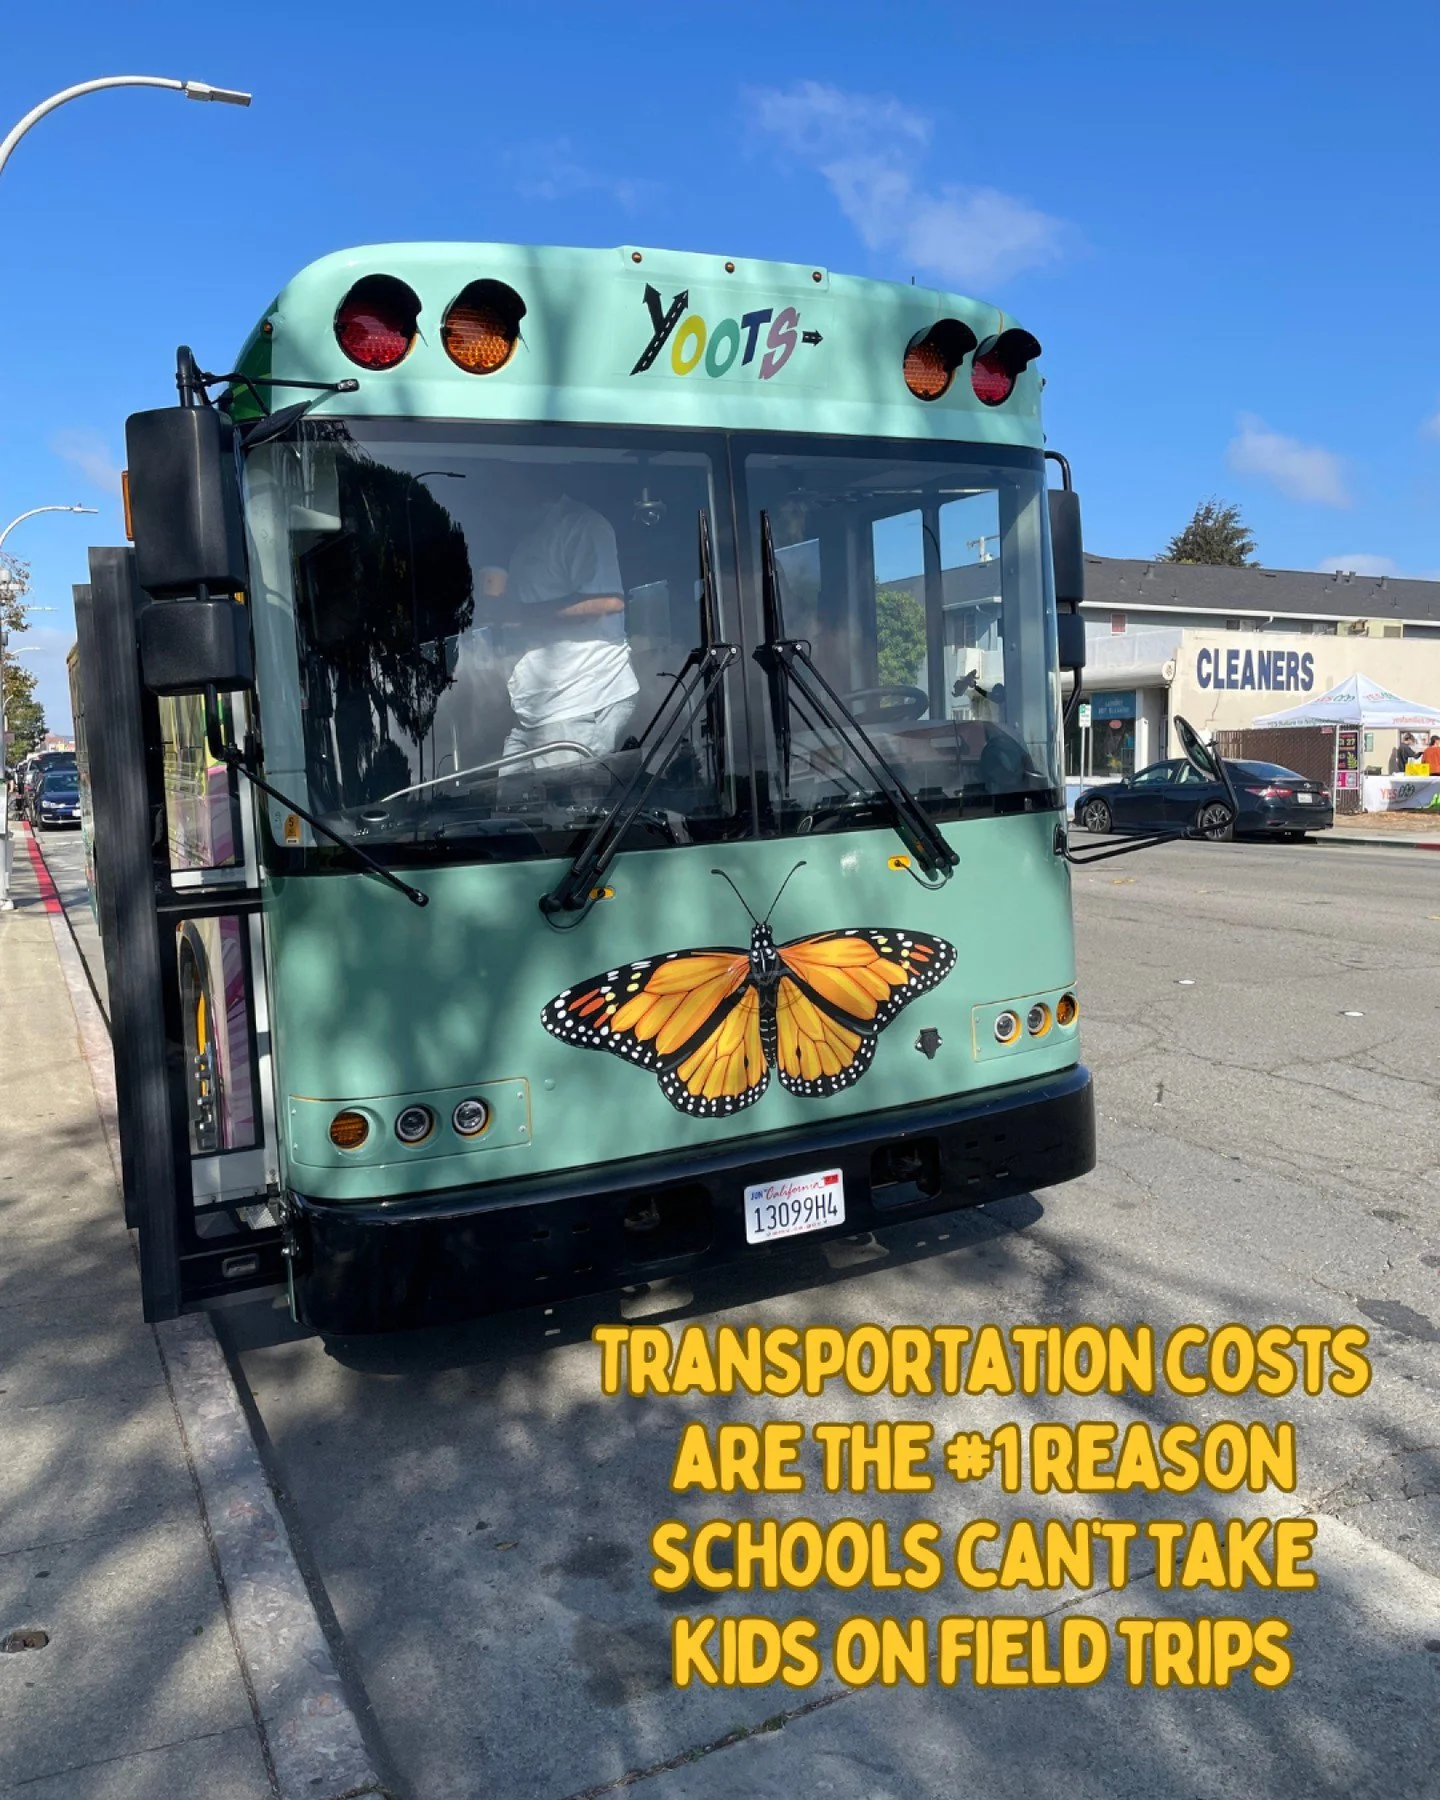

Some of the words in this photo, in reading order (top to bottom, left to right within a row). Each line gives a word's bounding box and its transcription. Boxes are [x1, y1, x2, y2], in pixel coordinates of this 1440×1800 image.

[630, 283, 801, 380] YOOTS
[1197, 647, 1314, 691] CLEANERS
[1380, 787, 1398, 800] YES
[766, 1182, 825, 1200] California
[754, 1192, 838, 1233] 13099H4
